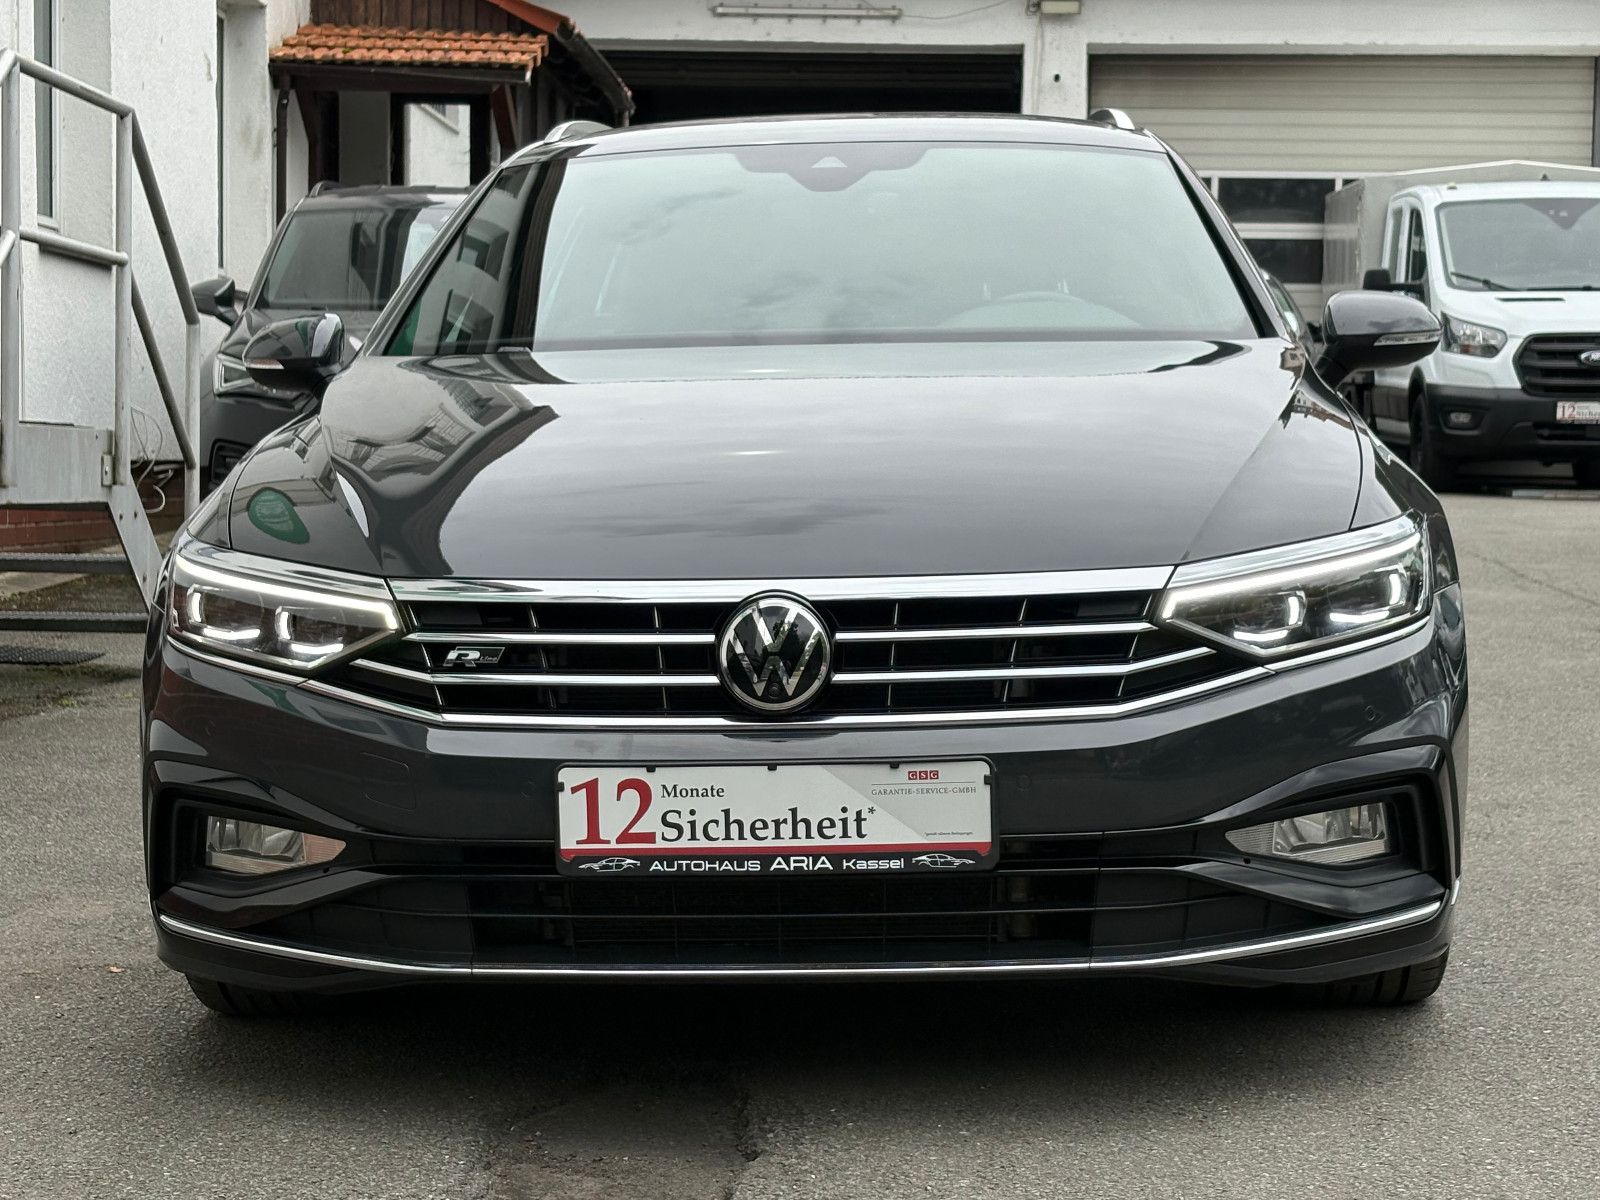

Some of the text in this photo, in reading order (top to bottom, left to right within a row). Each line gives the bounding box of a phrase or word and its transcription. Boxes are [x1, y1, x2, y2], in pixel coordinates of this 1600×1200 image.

[443, 650, 480, 667] R
[729, 605, 822, 697] VW
[908, 770, 939, 780] GSG
[660, 784, 725, 798] Monate
[871, 786, 977, 796] GARANTIE-SERVICE-GMBH
[570, 777, 657, 845] 12
[649, 856, 905, 872] AUTOHAUS ARIA Kassel
